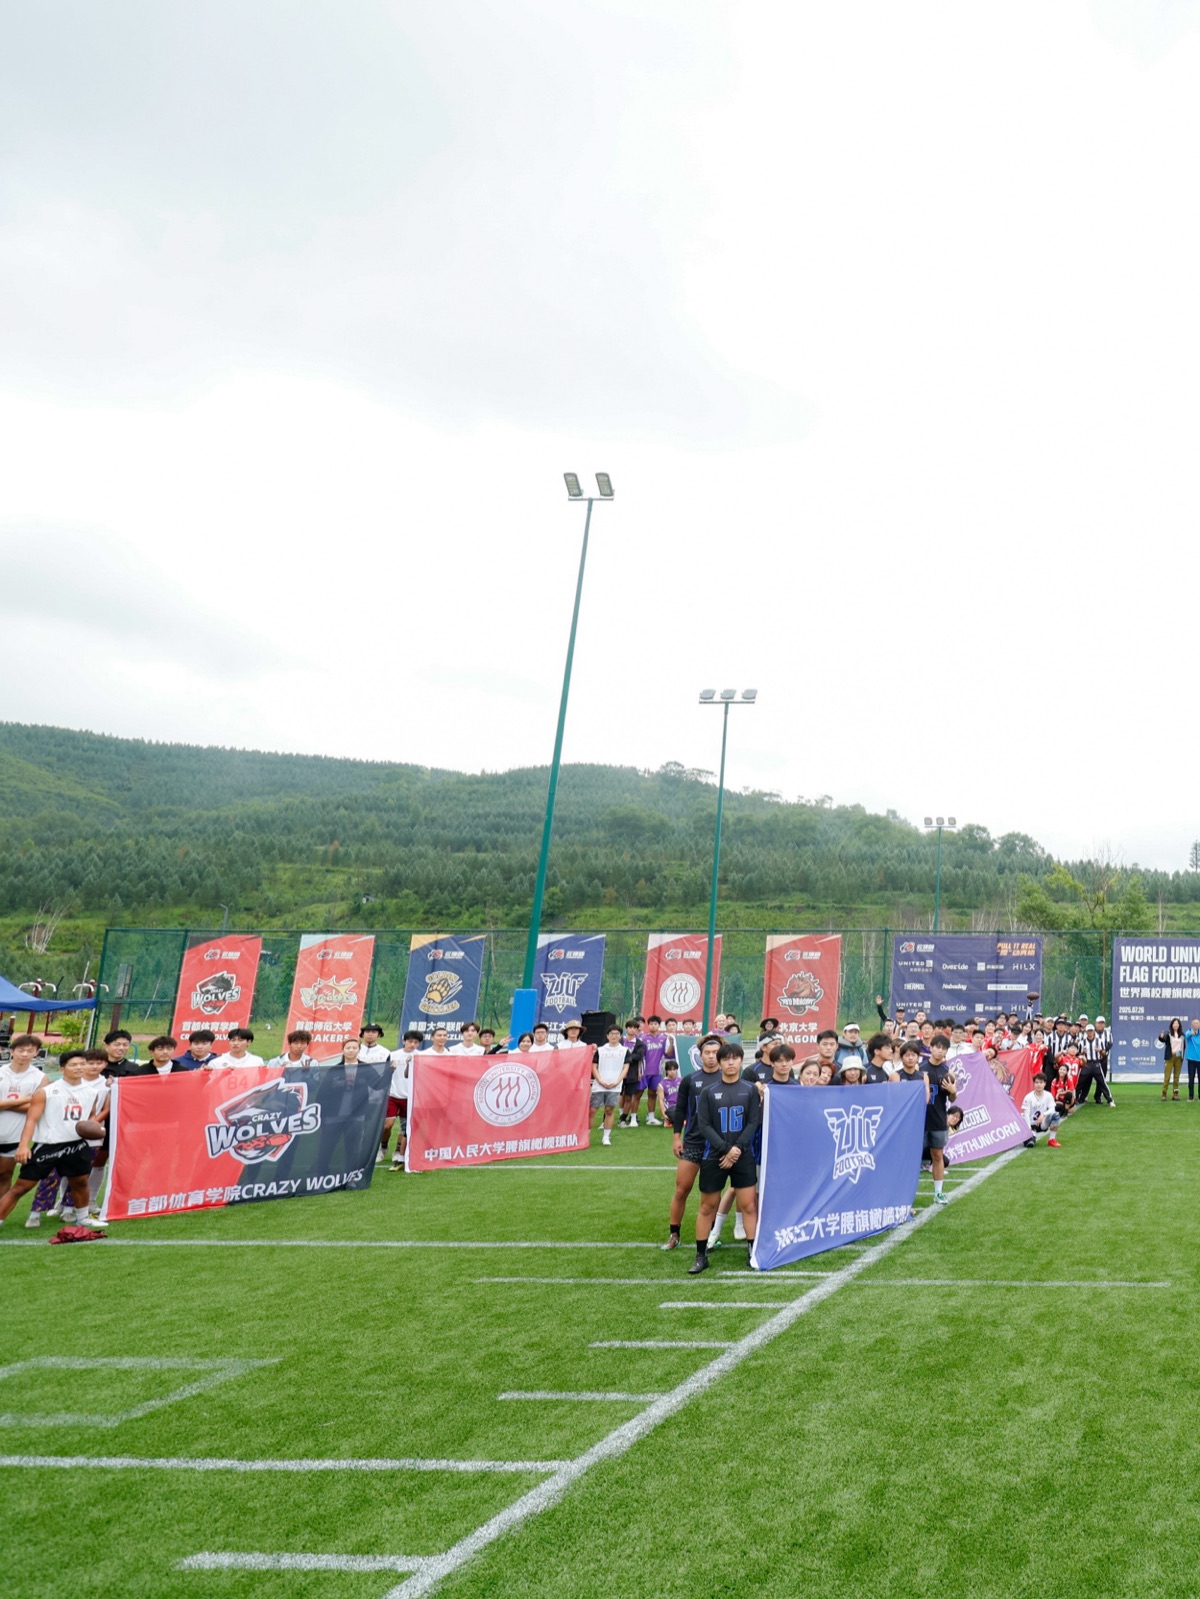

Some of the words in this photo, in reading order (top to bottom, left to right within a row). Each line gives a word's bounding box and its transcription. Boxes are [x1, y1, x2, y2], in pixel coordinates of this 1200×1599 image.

[1121, 946, 1167, 963] WORLD
[1119, 966, 1149, 983] FLAG
[192, 988, 239, 1008] WOLVES
[779, 1022, 818, 1032] 北京大学
[63, 1105, 83, 1121] 10
[251, 1112, 281, 1122] CRAZY
[718, 1105, 744, 1133] 16
[207, 1104, 319, 1156] WOLVES
[424, 1133, 578, 1161] 中国人民大学腰旗橄榄球队
[306, 1168, 363, 1191] WOLVES
